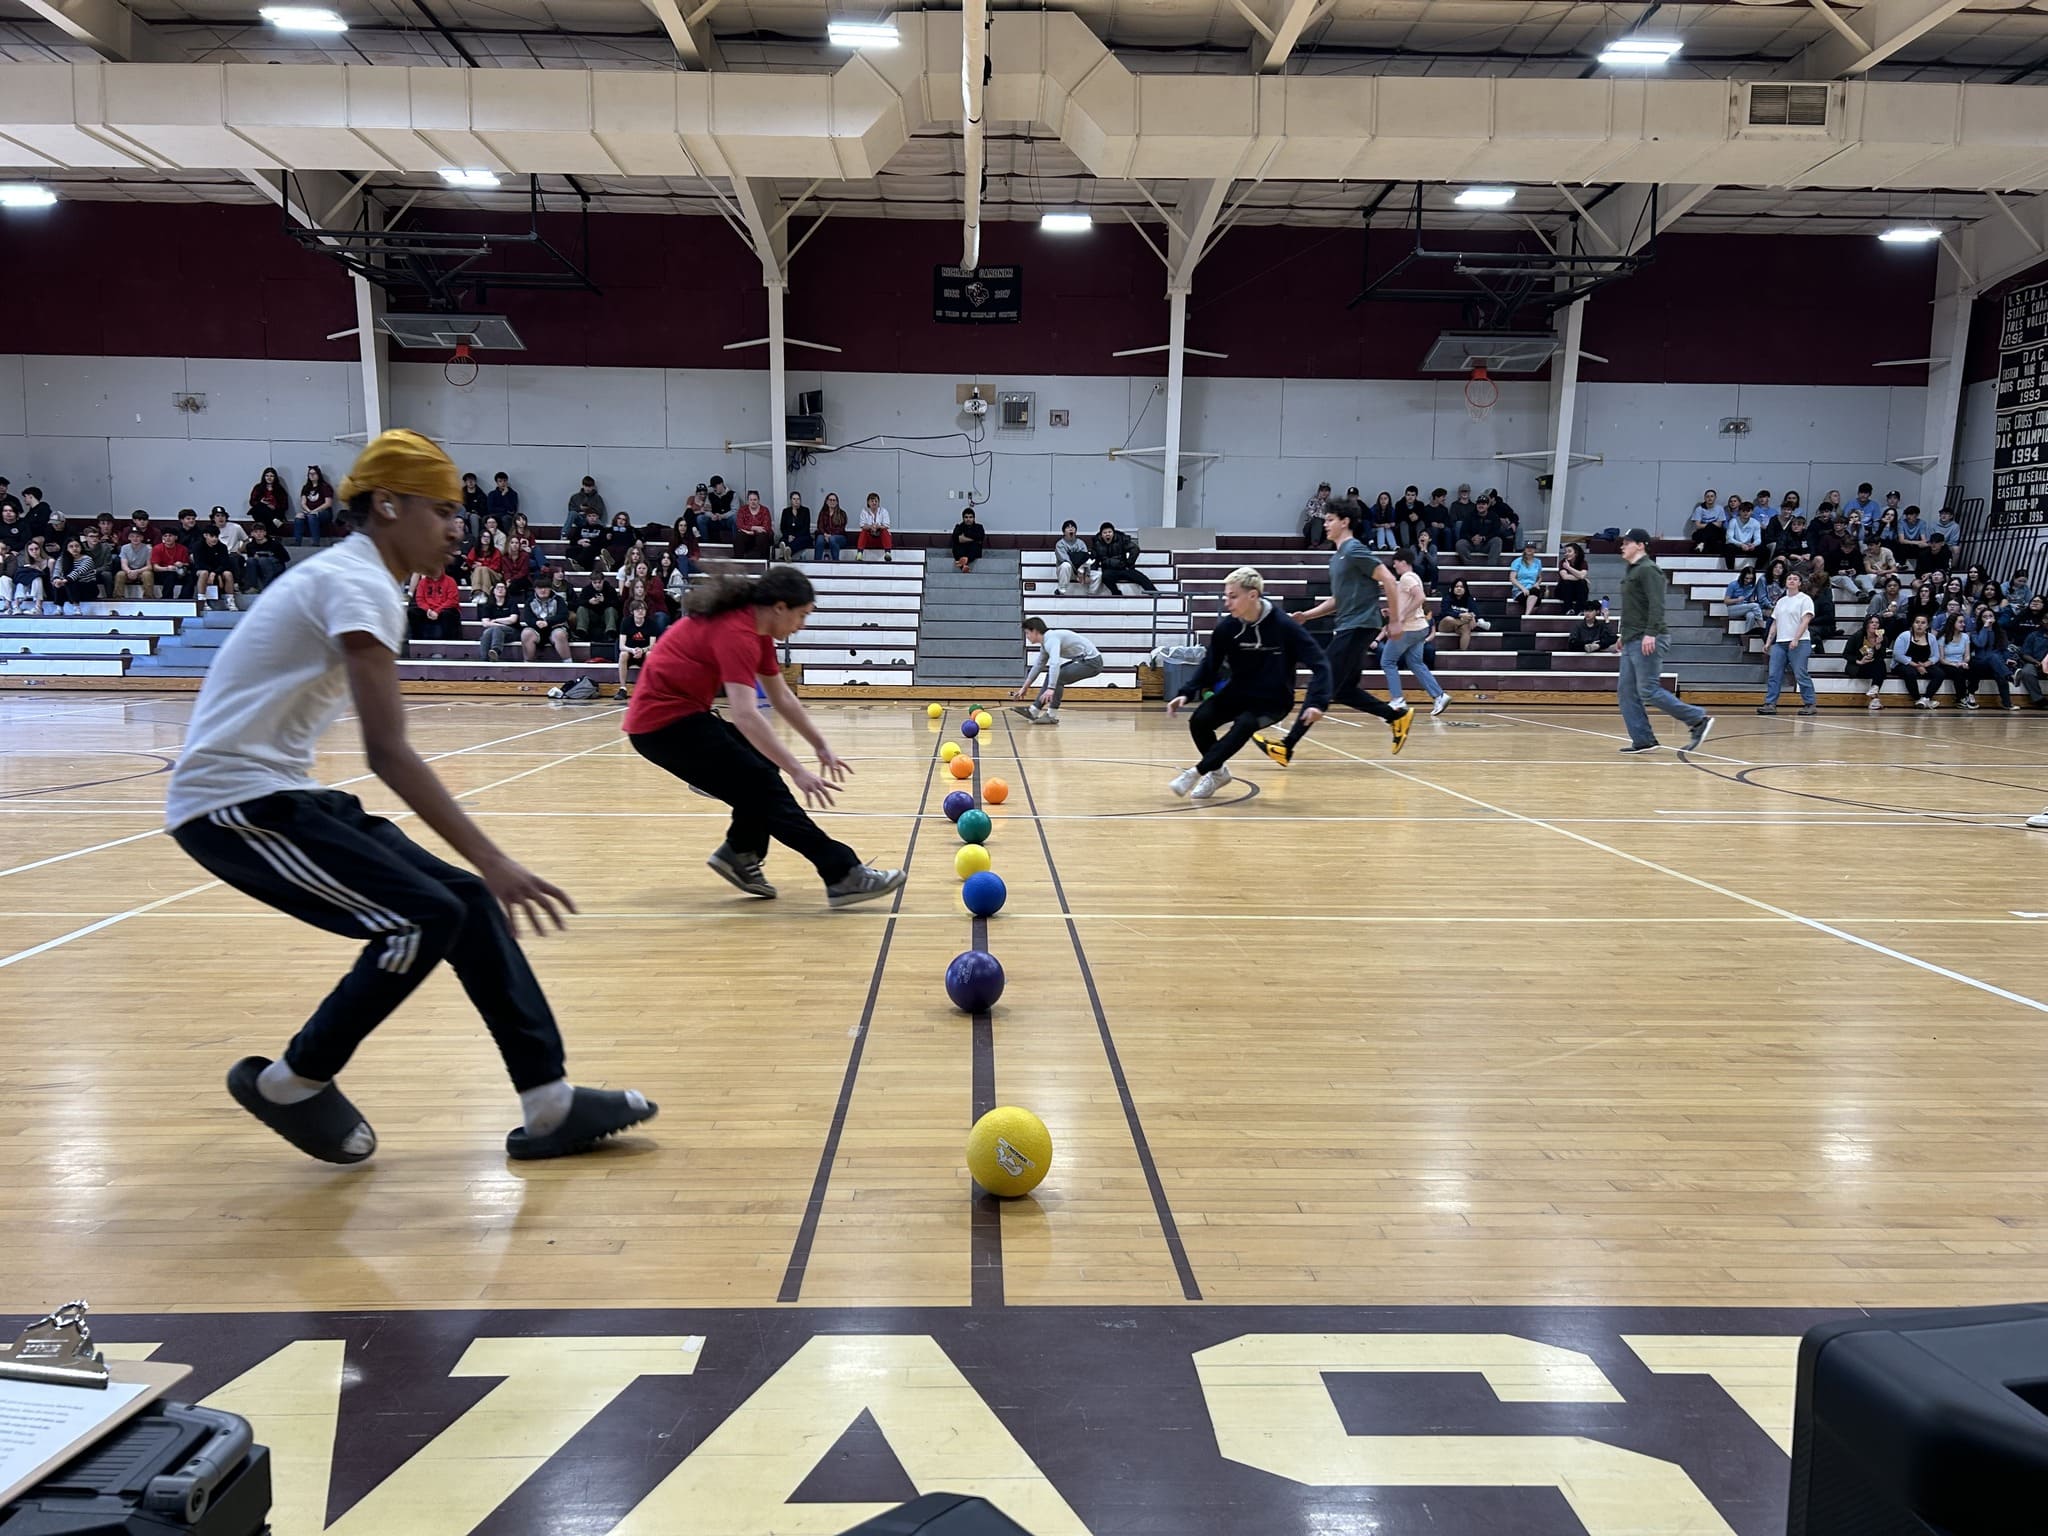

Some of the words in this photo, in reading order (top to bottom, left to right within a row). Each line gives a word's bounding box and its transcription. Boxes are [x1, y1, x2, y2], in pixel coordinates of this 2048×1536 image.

[2006, 305, 2026, 320] STATE
[2023, 349, 2045, 364] DAC
[2017, 377, 2035, 391] CROSS
[2019, 389, 2041, 403] 1993
[1997, 417, 2012, 432] BOYS
[2014, 414, 2033, 430] CROSS
[2011, 446, 2039, 464] 1994
[1997, 474, 2014, 487] BOYS
[1997, 486, 2026, 499] EASTERN
[2030, 484, 2048, 497] MAINE
[2004, 499, 2039, 511] RUNNER-UP
[1999, 513, 2017, 525] CSS
[2018, 512, 2023, 523] C
